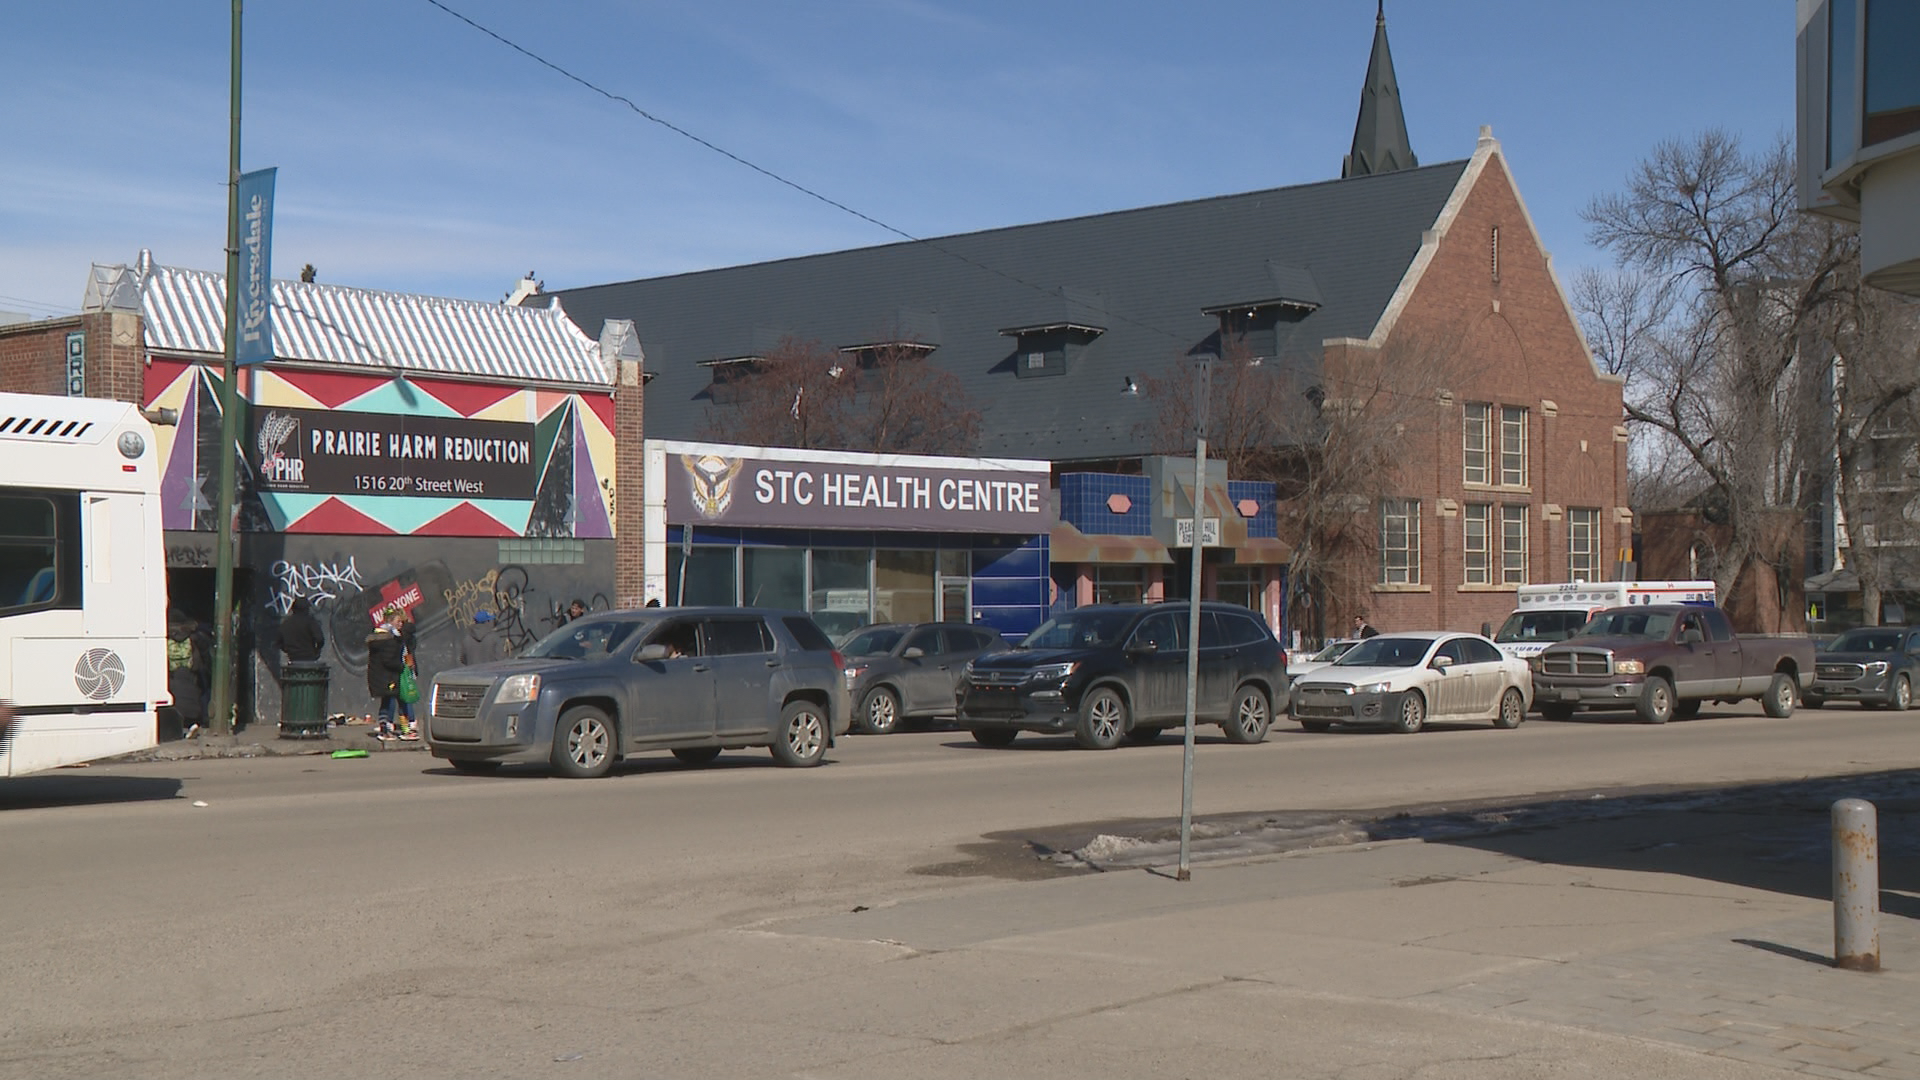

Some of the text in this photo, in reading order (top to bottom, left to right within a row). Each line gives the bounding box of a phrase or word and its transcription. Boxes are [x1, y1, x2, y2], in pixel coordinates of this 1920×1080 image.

[243, 194, 266, 342] Riversdale
[311, 429, 530, 464] PRAIRIE HARM REDUCTION
[275, 457, 304, 480] PHR
[354, 475, 484, 493] 1516 20th Street West
[755, 469, 1040, 513] STC HEALTH CENTRE
[372, 588, 420, 624] NAOXONE
